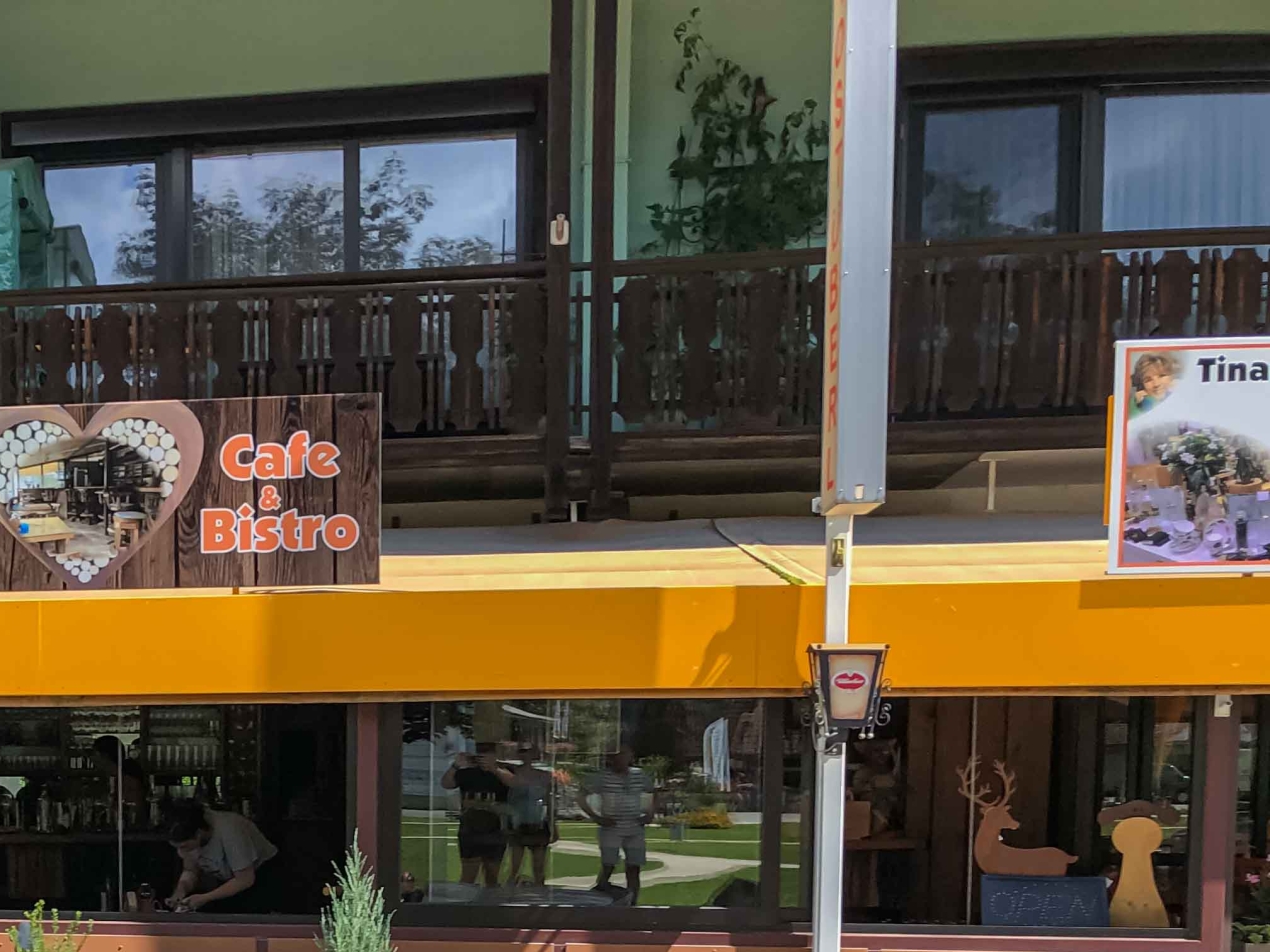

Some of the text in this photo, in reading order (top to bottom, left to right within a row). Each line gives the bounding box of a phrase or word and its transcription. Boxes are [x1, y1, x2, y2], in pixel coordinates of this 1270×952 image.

[826, 0, 847, 491] OSTÜBERL
[1197, 355, 1270, 383] Tina
[220, 430, 341, 481] Cafe
[259, 485, 281, 510] &
[200, 503, 360, 553] Bistro
[990, 892, 1099, 919] OPEN
